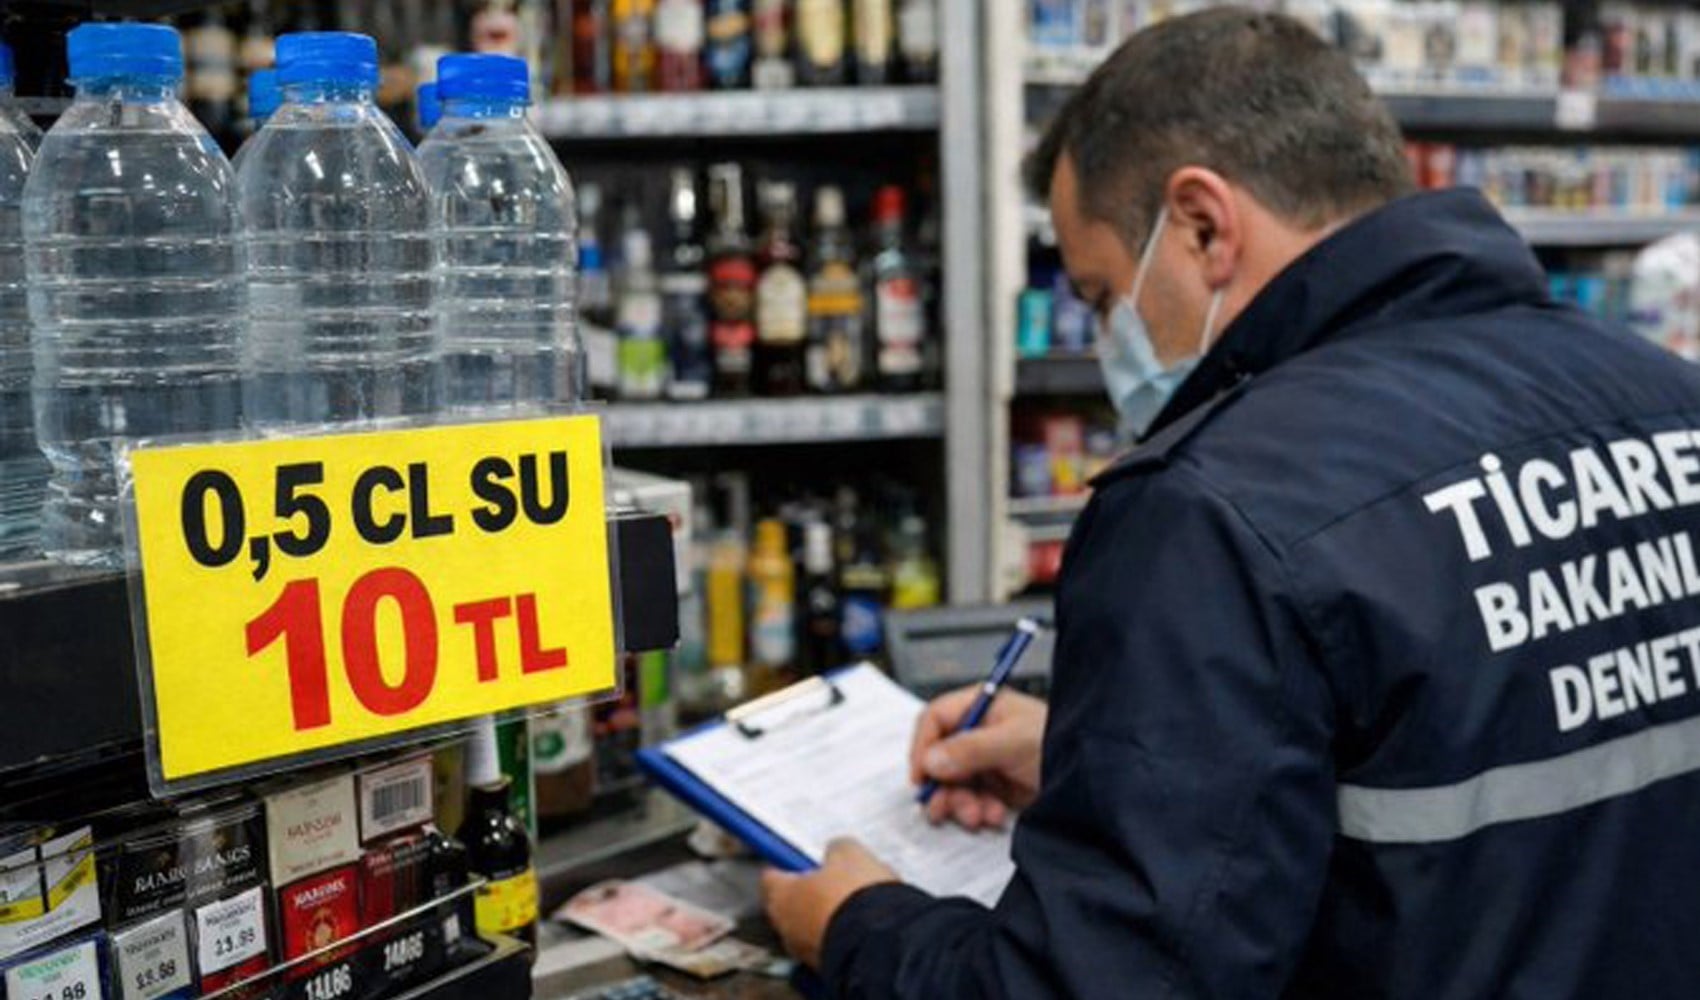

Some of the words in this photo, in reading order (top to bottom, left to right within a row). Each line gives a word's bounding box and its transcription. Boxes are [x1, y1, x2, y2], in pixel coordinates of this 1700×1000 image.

[182, 462, 331, 581] 0,5
[352, 463, 454, 544] CL
[471, 451, 570, 532] SU
[1423, 430, 1700, 562] TİCARE
[245, 566, 438, 731] 10
[453, 593, 568, 683] TL
